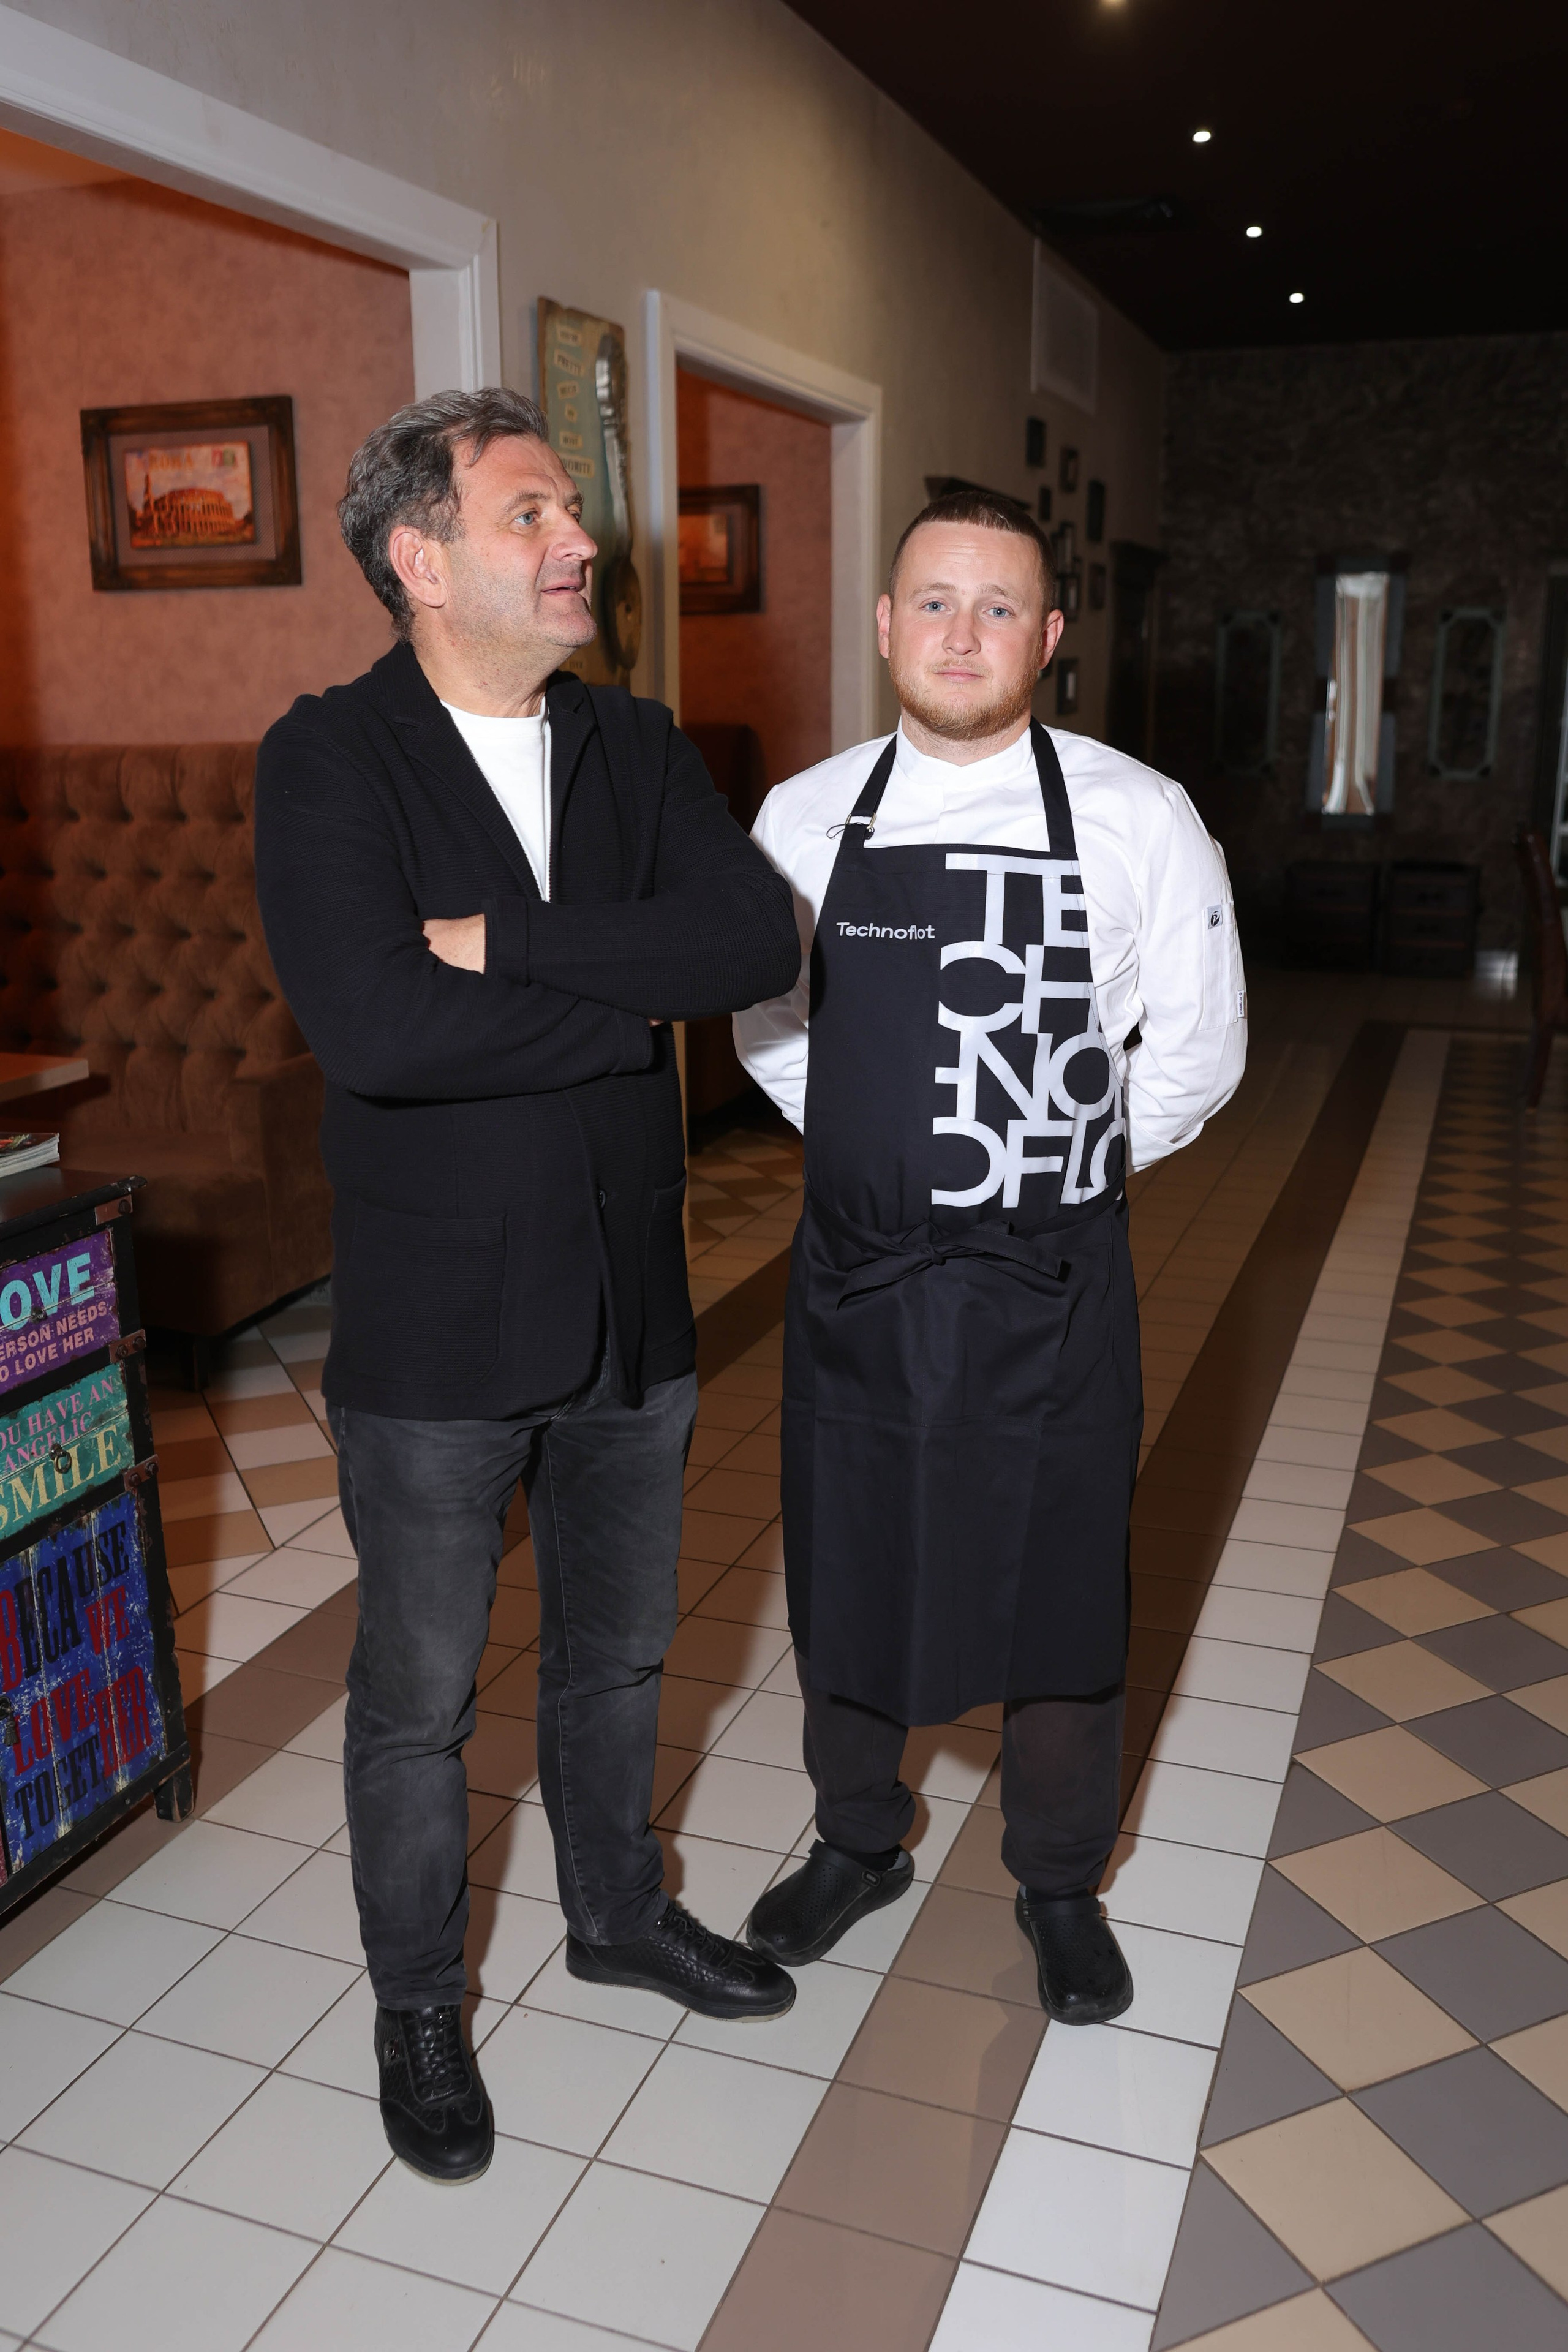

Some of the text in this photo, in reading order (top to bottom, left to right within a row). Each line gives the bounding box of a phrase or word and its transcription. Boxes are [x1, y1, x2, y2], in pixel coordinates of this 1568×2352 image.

[836, 922, 935, 940] Technoflot
[56, 1301, 107, 1335] NEEDS
[15, 1343, 59, 1375] LOVE
[62, 1327, 95, 1354] HER
[27, 1392, 84, 1436] HAVE
[89, 1376, 115, 1406] AN
[4, 1411, 92, 1473] ANGELIC
[0, 1521, 130, 1692] BECAUSE
[85, 1586, 130, 1656] WE
[13, 1667, 96, 1776] LOVE
